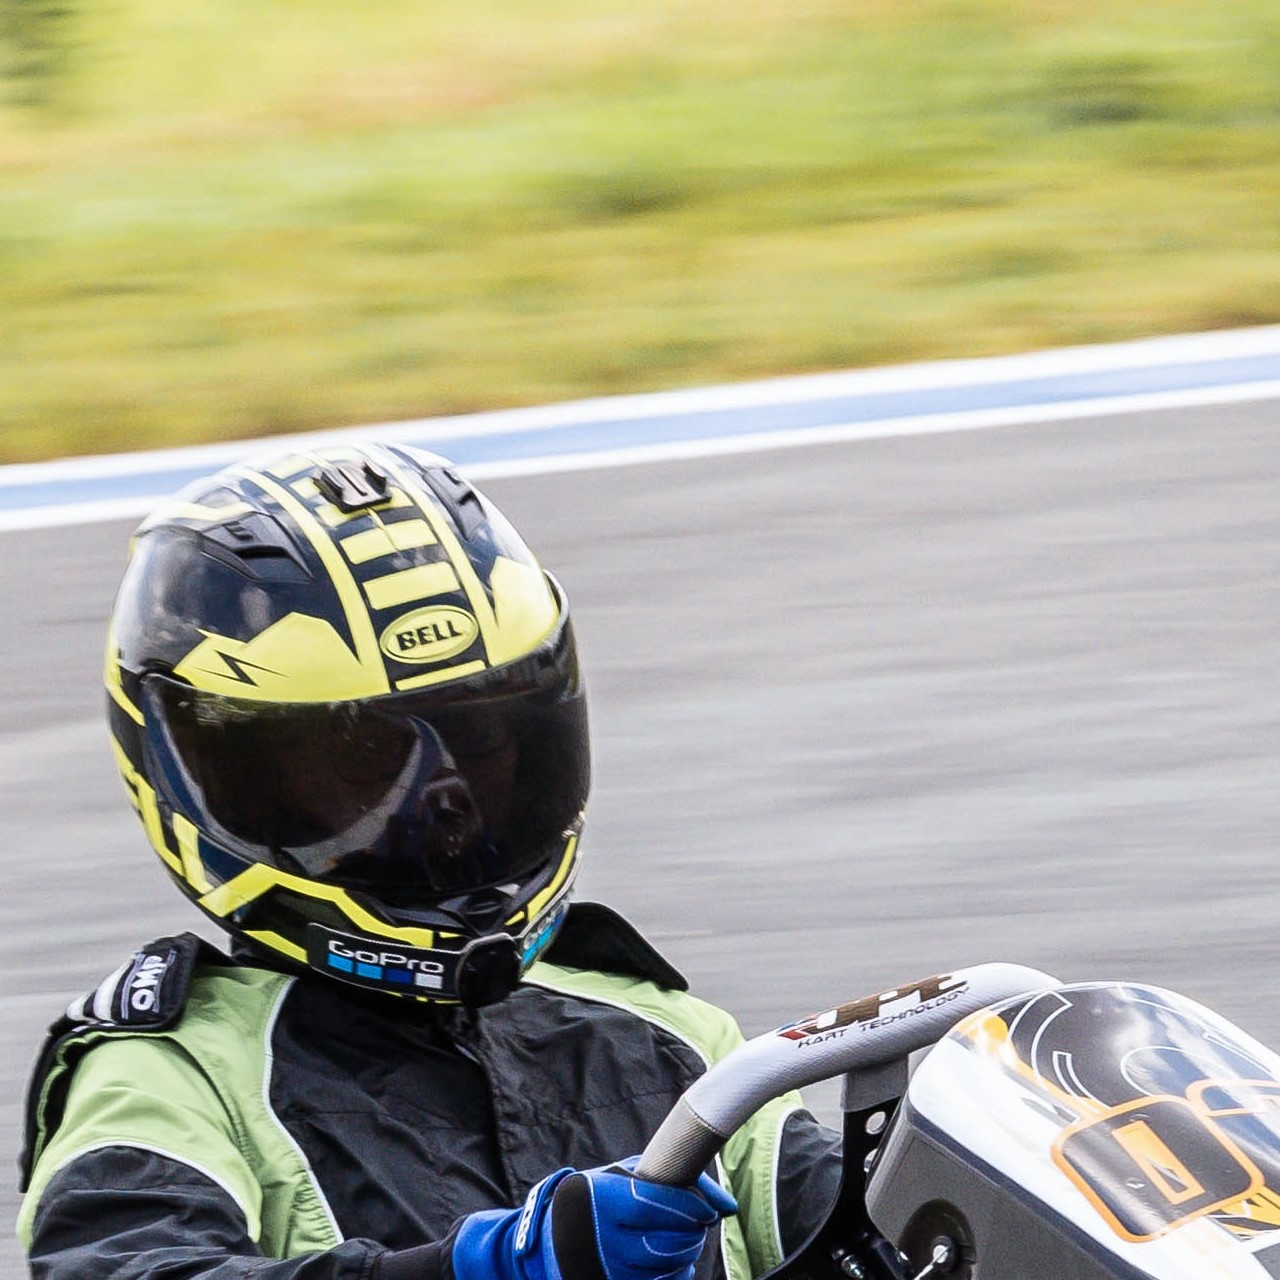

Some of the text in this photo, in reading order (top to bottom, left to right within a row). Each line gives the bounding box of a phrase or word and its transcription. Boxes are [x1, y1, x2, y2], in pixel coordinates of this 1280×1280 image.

[396, 620, 462, 651] BELL
[328, 940, 444, 974] GoPro
[131, 955, 168, 1011] OMP
[798, 987, 970, 1048] KART TECHNOLOGY
